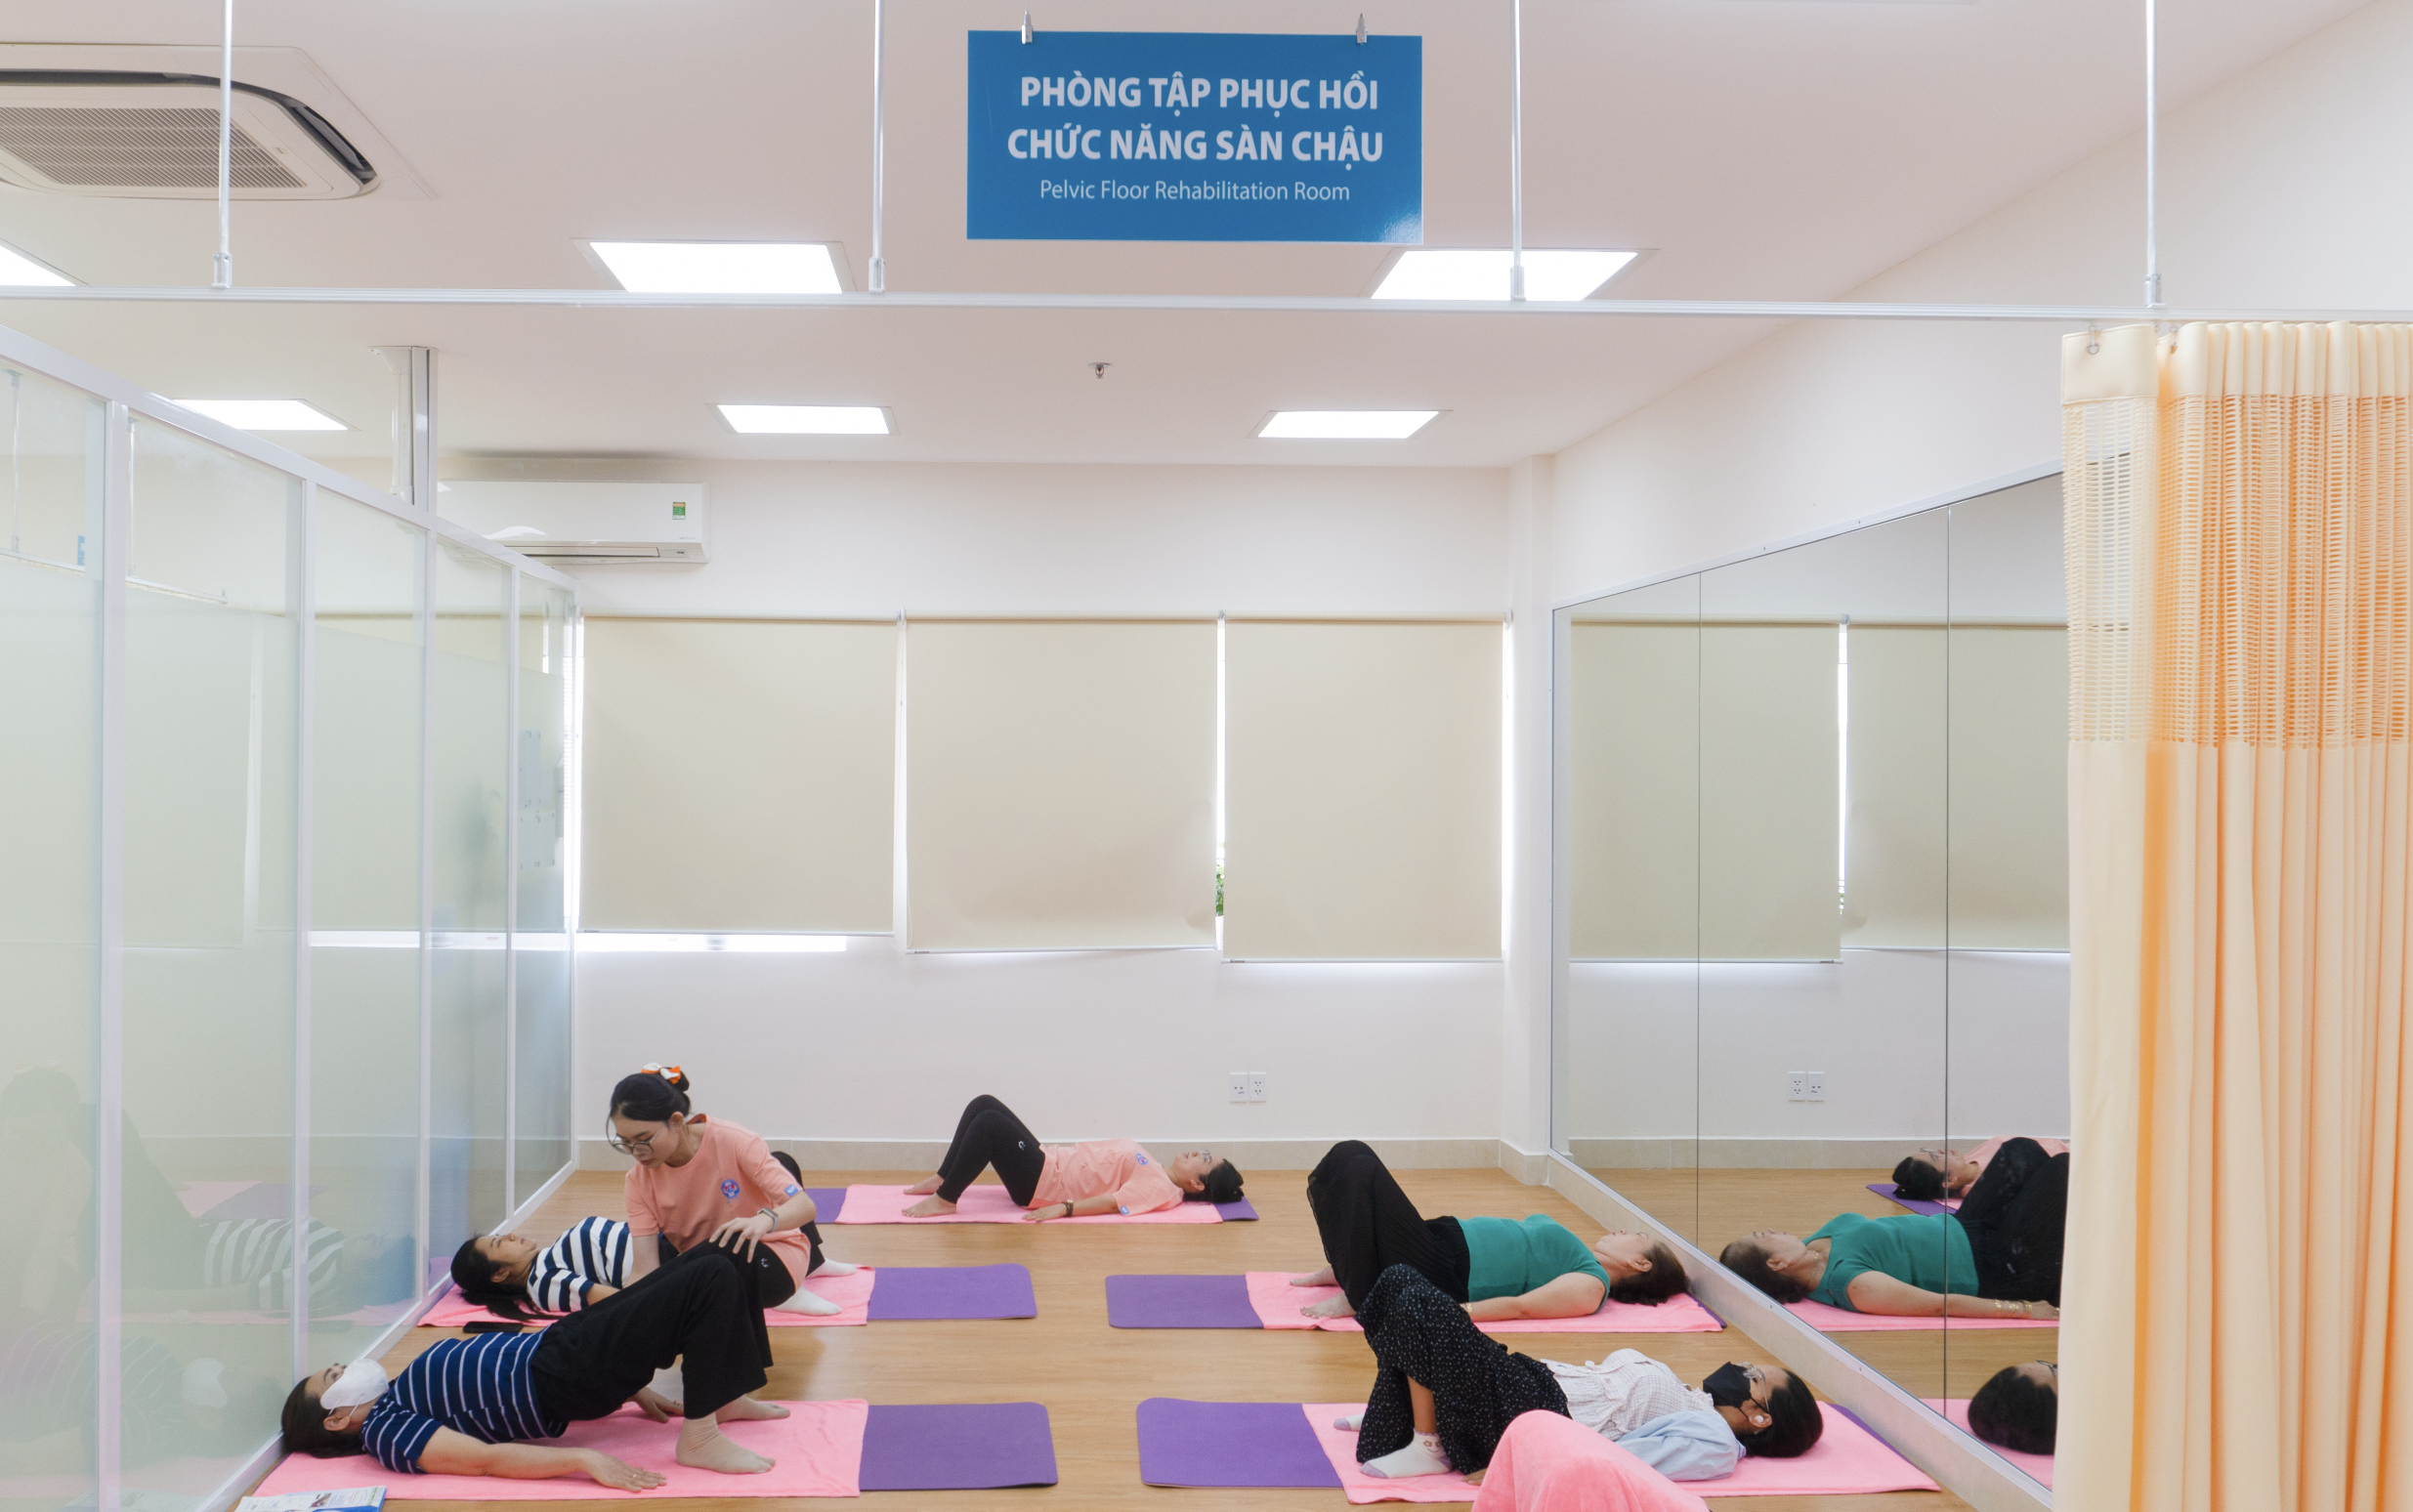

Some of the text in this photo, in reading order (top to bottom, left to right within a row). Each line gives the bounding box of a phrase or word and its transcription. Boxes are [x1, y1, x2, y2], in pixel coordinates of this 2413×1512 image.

[1021, 69, 1377, 117] PHÒNG TẬP PHỤC HỒI
[1007, 122, 1383, 171] CHỨC NĂNG SÀN CHẬU
[1040, 180, 1350, 201] Pelvic Floor Rehabilitation Room
